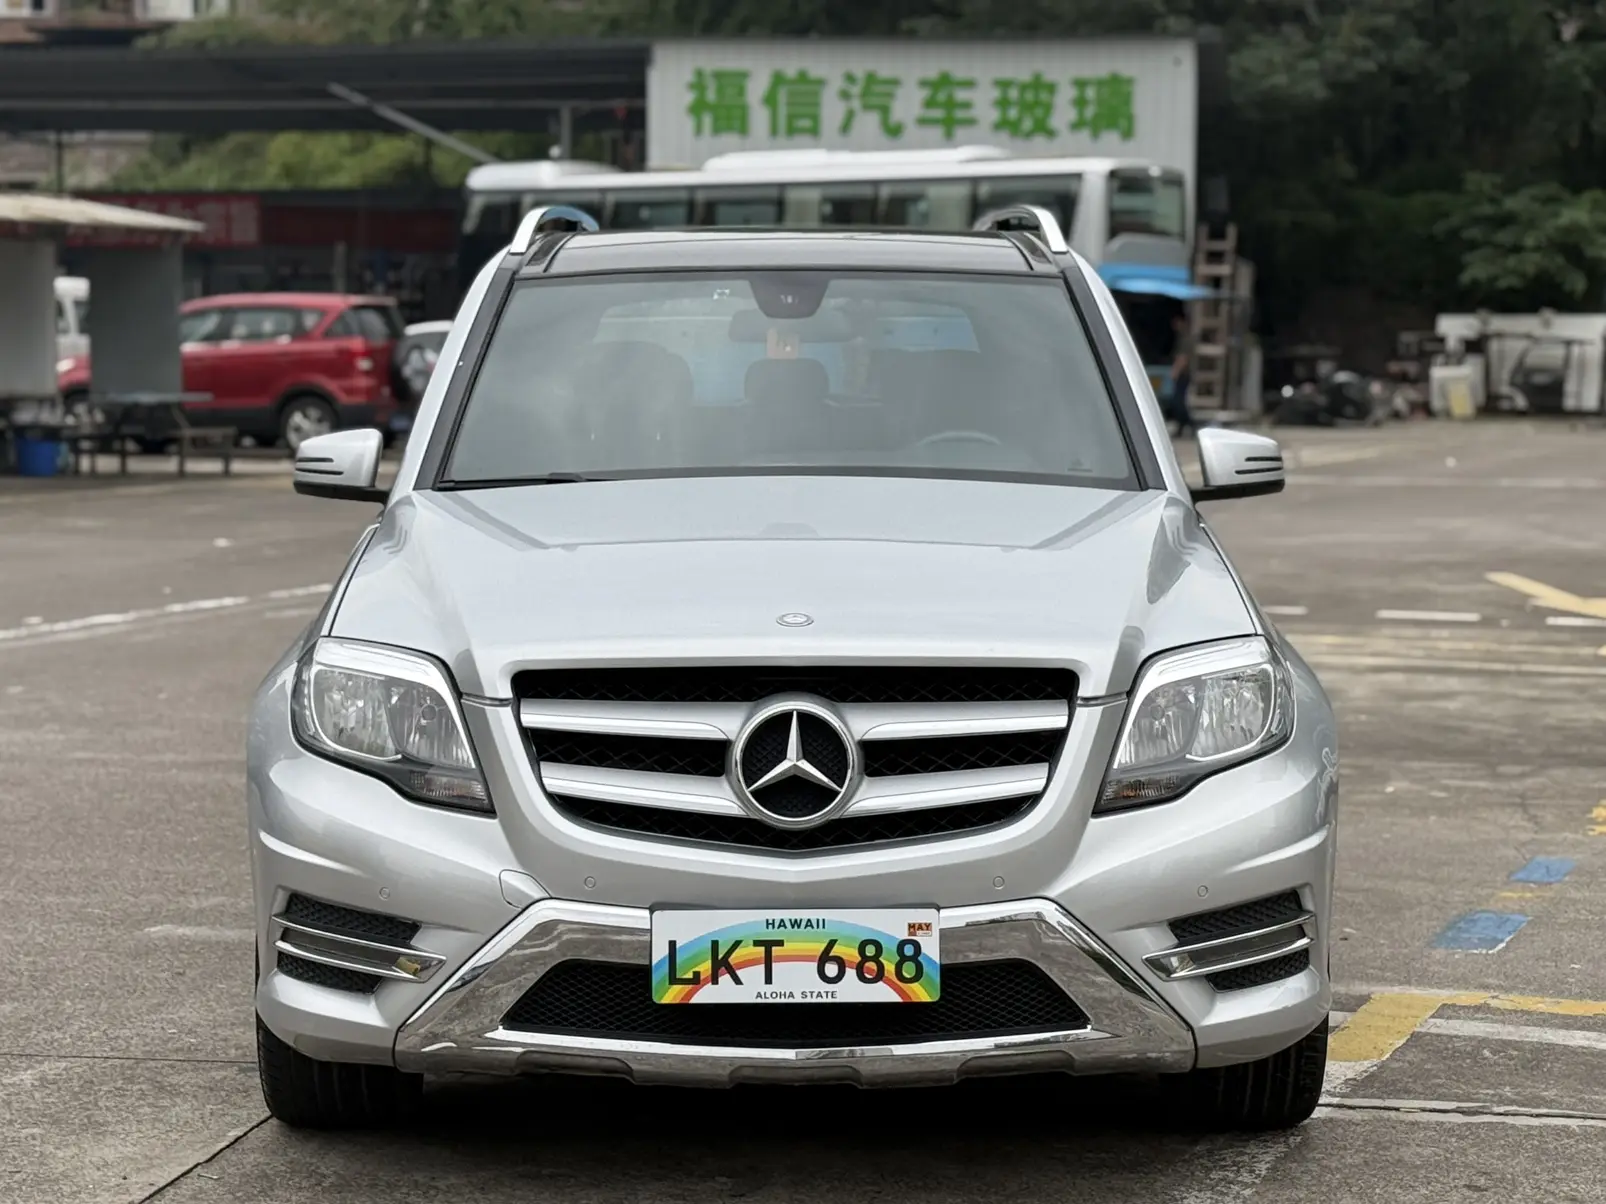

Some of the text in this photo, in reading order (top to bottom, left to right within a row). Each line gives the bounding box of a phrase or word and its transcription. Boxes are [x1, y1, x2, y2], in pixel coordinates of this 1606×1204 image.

[686, 67, 1137, 142] 福信汽车玻璃
[765, 918, 827, 930] HAWAII
[908, 922, 932, 931] MAY
[668, 938, 924, 986] LKT 688
[755, 990, 838, 1000] ALOHA STATE
